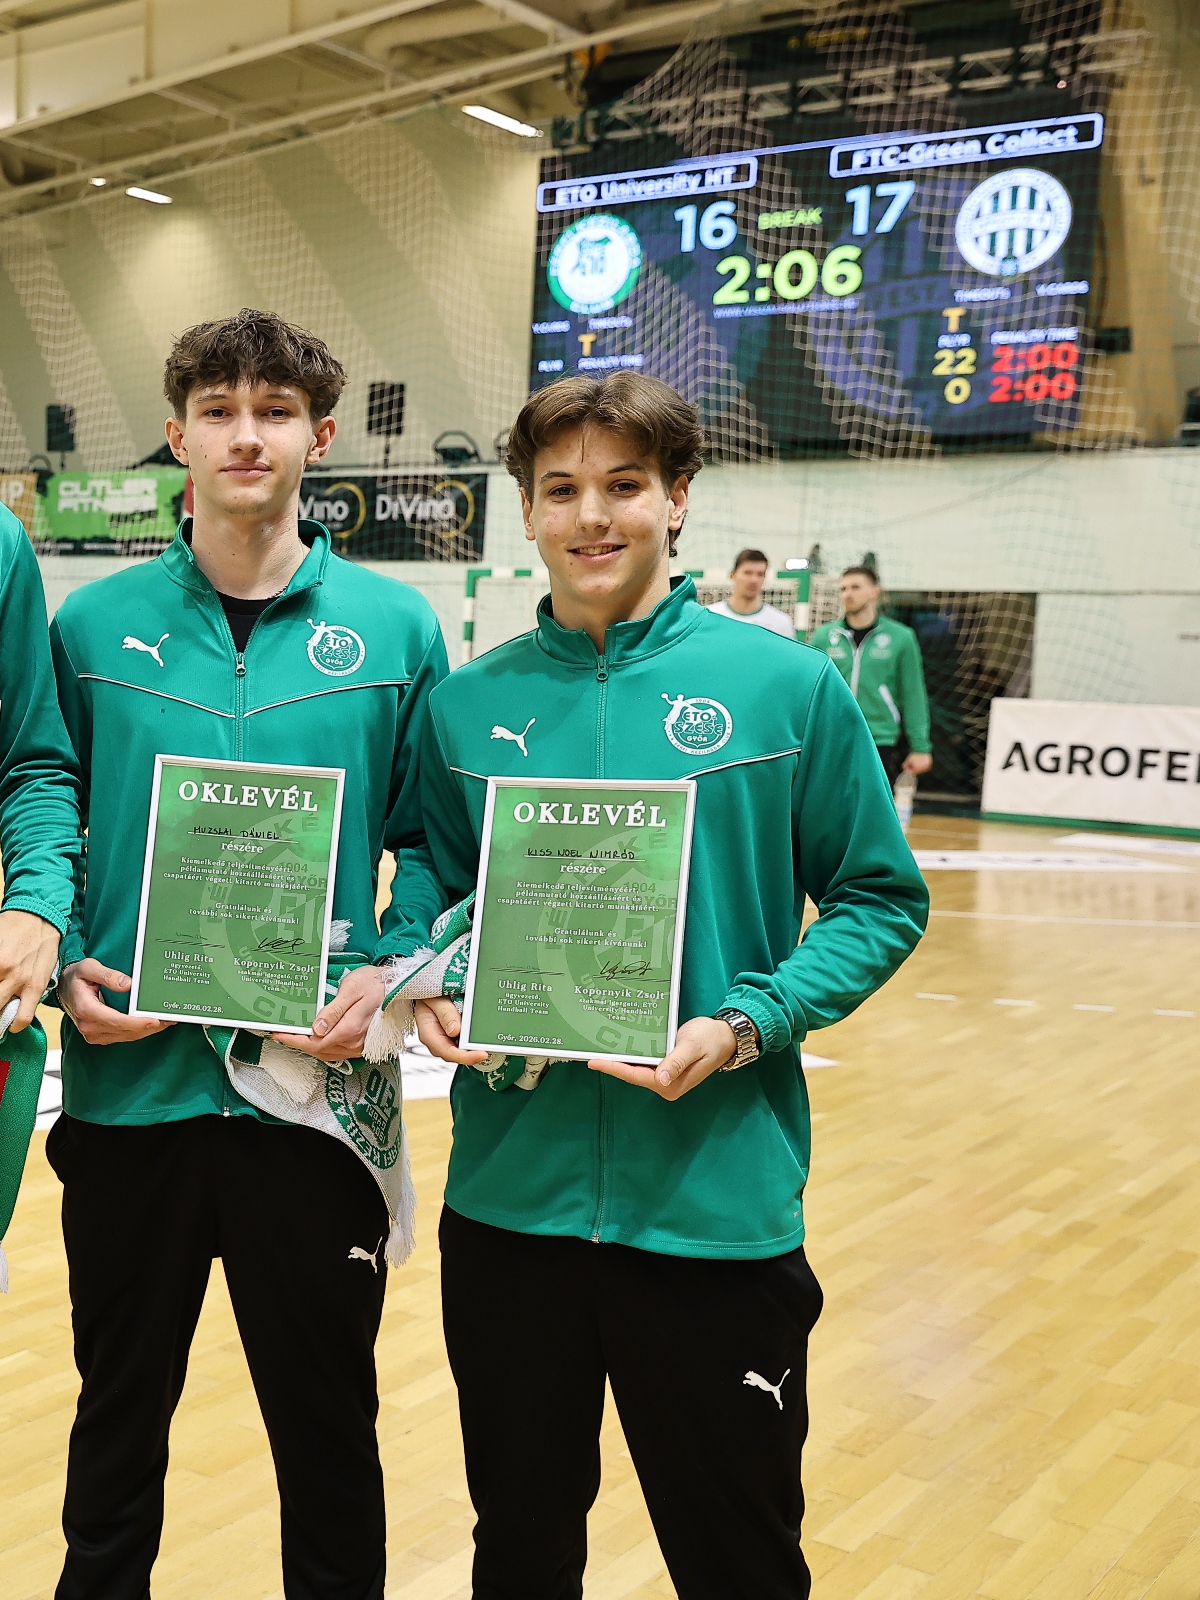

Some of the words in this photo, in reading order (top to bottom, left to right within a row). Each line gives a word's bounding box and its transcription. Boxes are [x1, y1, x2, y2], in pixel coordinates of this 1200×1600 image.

[985, 124, 1078, 154] Collect
[556, 185, 598, 205] ETO
[601, 172, 702, 199] University
[704, 166, 736, 186] HT
[758, 206, 824, 230] BREAK
[846, 180, 916, 236] 17
[674, 200, 738, 252] 16
[712, 244, 862, 305] 2:06
[942, 306, 967, 332] T
[578, 333, 596, 356] T
[991, 342, 1079, 373] 2:00
[932, 348, 977, 376] 22
[944, 377, 971, 404] 0
[988, 372, 1076, 402] 2:00
[376, 494, 456, 521] DiVino
[178, 781, 317, 812] OKLEVÉL
[514, 800, 666, 827] OKLEVÉL
[240, 826, 279, 839] DÁNIEL
[221, 841, 263, 853] részére
[527, 847, 552, 856] KISS
[589, 847, 635, 859] NIMRÓD
[560, 863, 606, 874] részére
[163, 950, 190, 962] Uhlig
[193, 953, 213, 962] Rita
[233, 957, 285, 970] Kopornyik
[289, 963, 314, 972] Zsolt
[498, 980, 527, 991] Uhlig
[530, 982, 552, 991] Rita
[574, 985, 631, 998] Kopornyik
[636, 989, 664, 999] Zsolt
